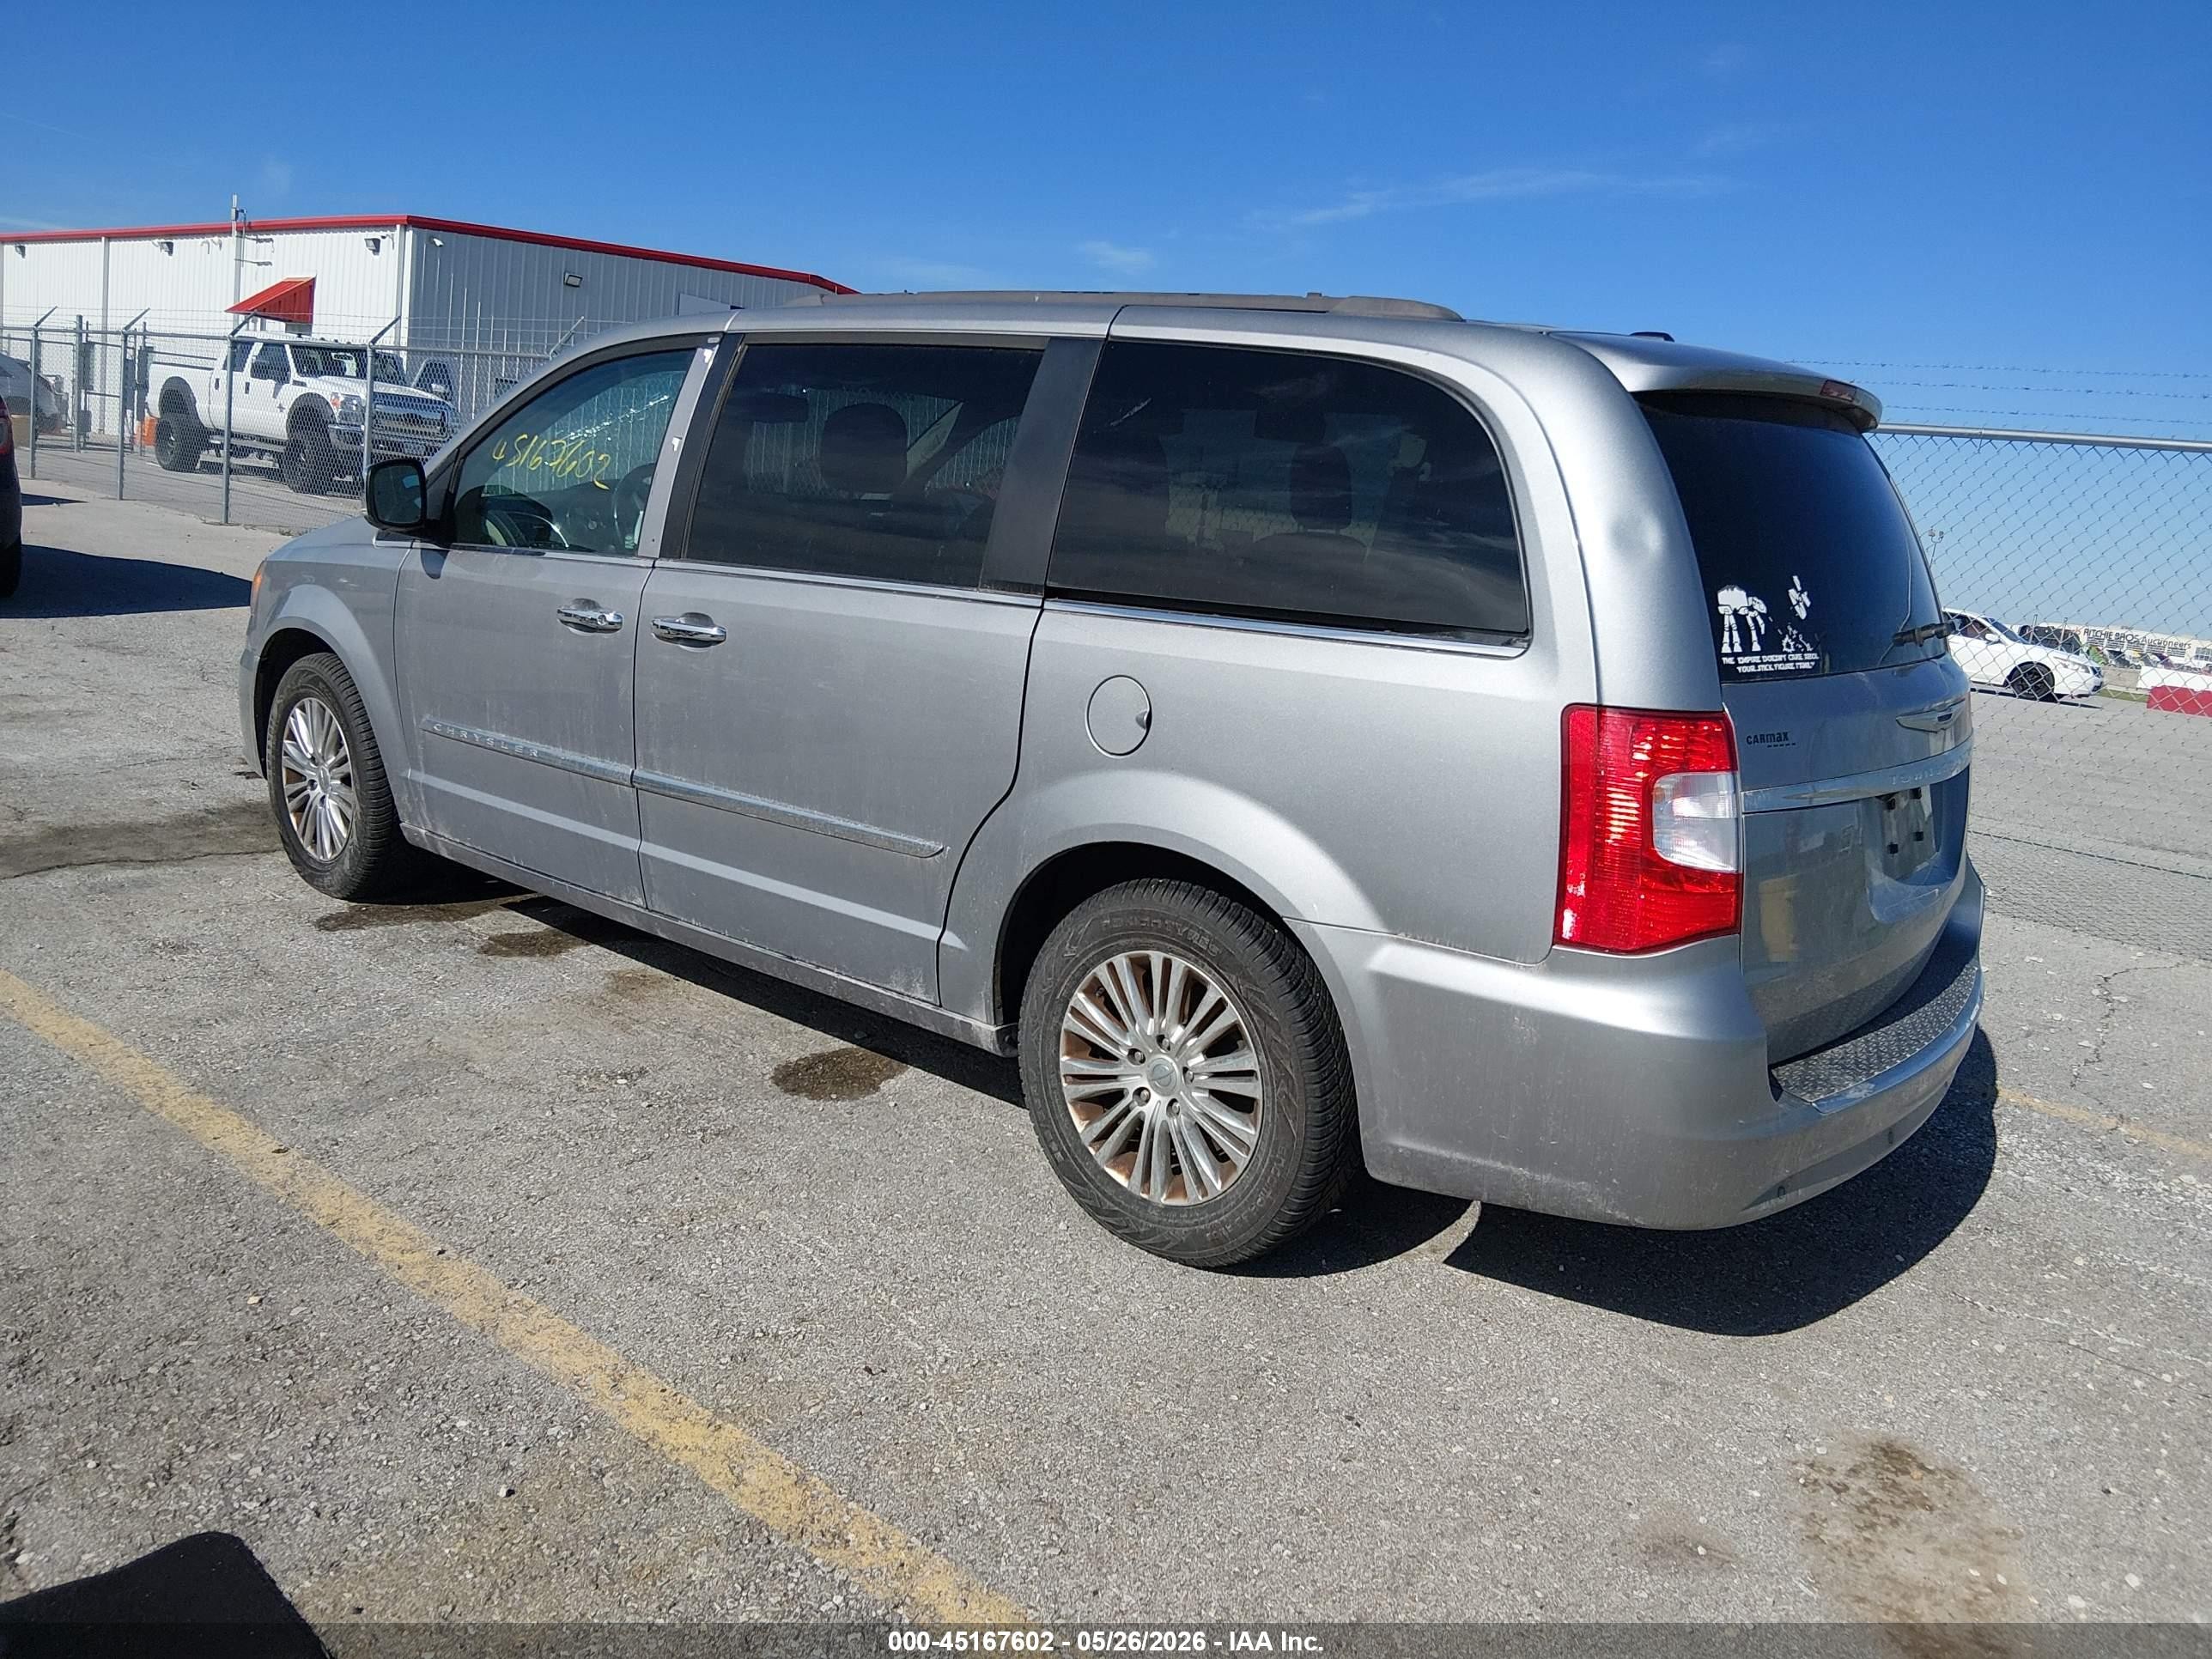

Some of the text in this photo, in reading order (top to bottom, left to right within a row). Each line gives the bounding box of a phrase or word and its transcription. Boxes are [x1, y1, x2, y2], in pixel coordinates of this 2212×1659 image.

[2083, 628, 2191, 649] RITCHIE BROS Auctioneers
[433, 723, 538, 757] CHRYSLER
